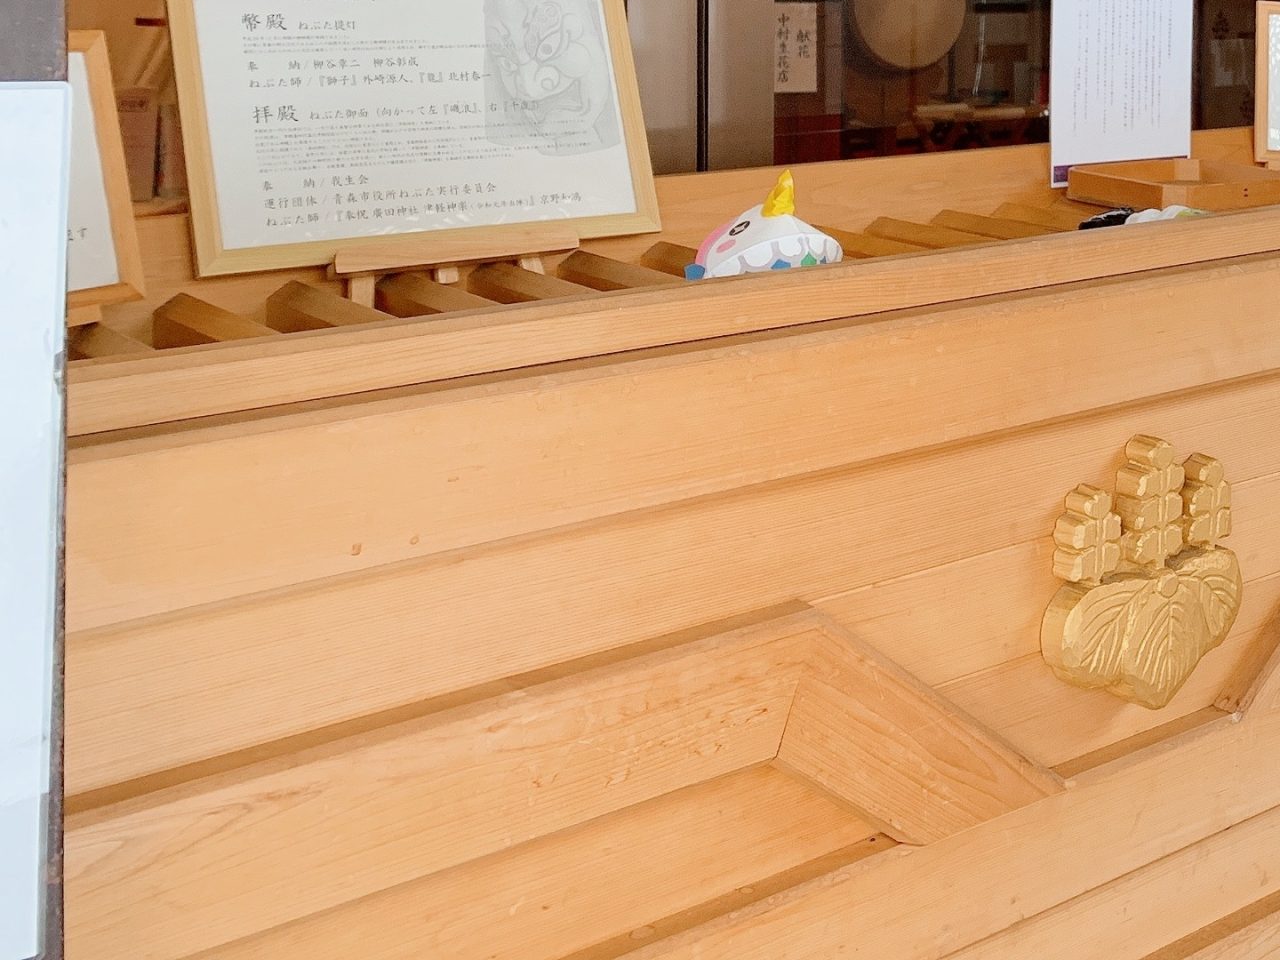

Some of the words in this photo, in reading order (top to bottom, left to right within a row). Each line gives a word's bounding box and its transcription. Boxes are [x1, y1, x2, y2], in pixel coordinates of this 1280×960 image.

[241, 13, 287, 32] 幣殿
[299, 20, 356, 31] ねぶた提灯
[778, 12, 791, 83] 中村生花店
[796, 29, 811, 58] 献花
[253, 105, 299, 124] 拝殿
